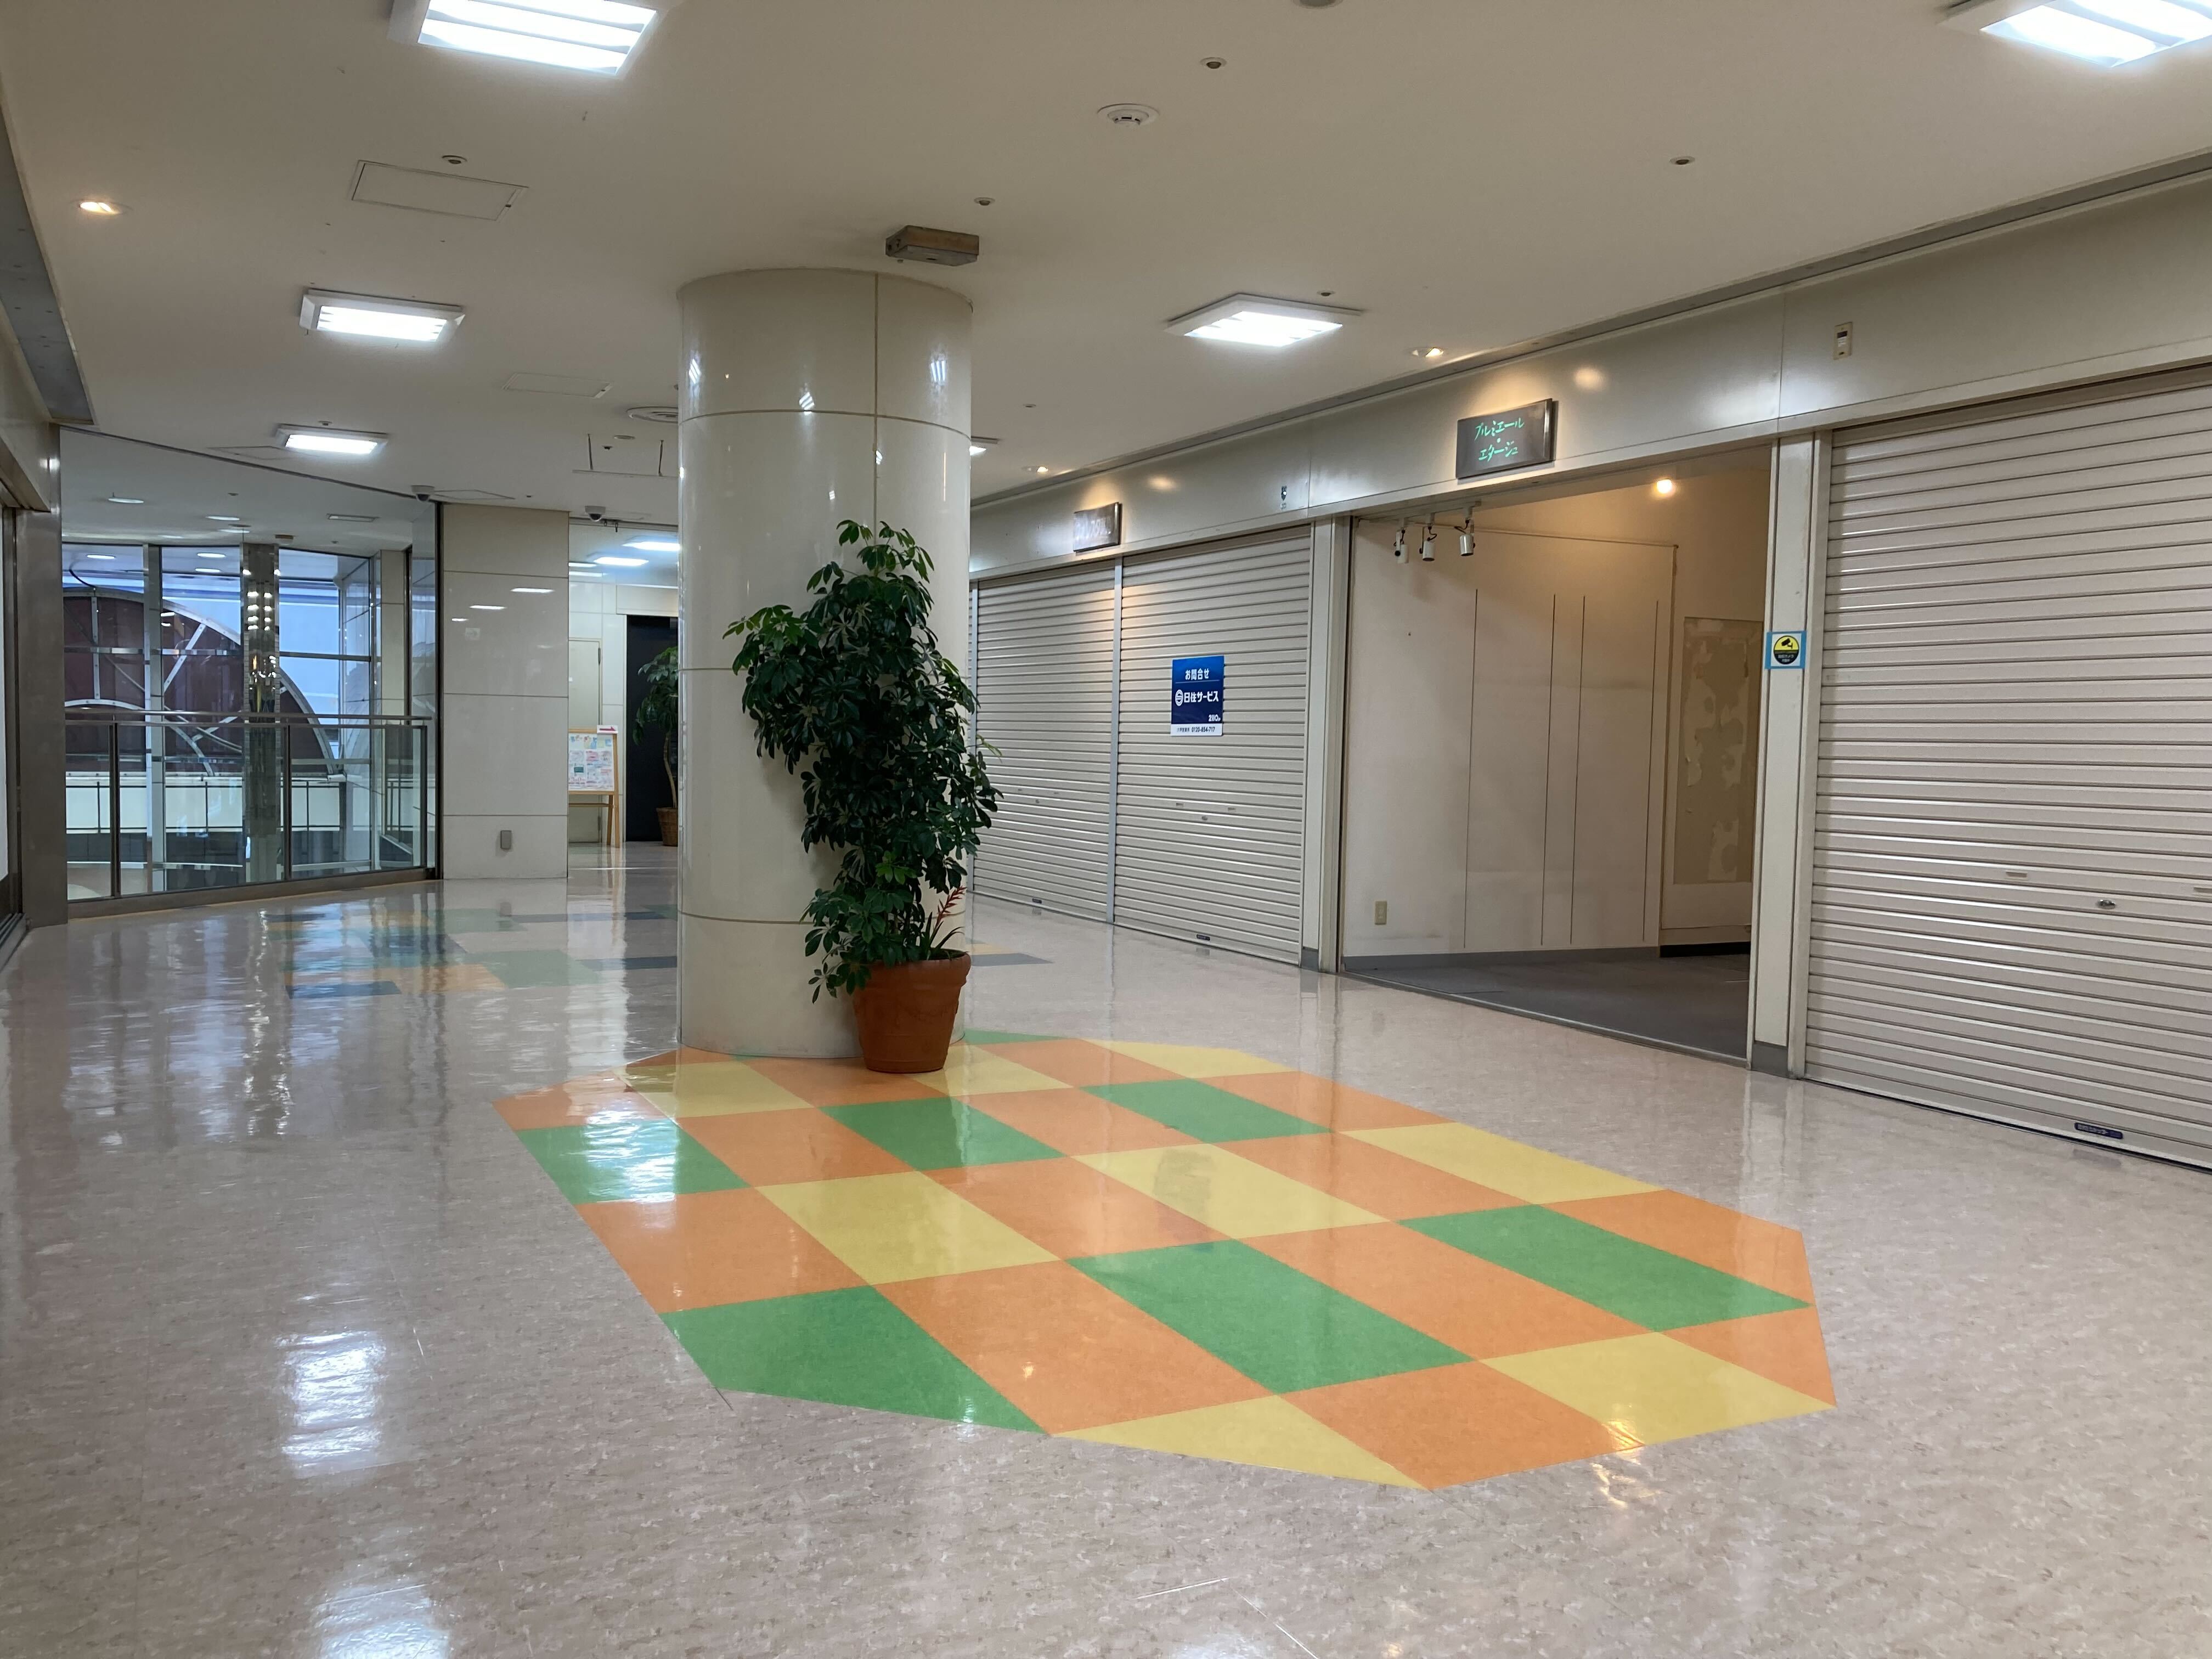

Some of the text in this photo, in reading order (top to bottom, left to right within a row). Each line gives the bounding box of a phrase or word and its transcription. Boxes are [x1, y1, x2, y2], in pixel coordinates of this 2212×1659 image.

[1478, 441, 1519, 462] エタージュ
[1185, 668, 1210, 680] お問合せ
[1183, 691, 1219, 703] 日住サービス
